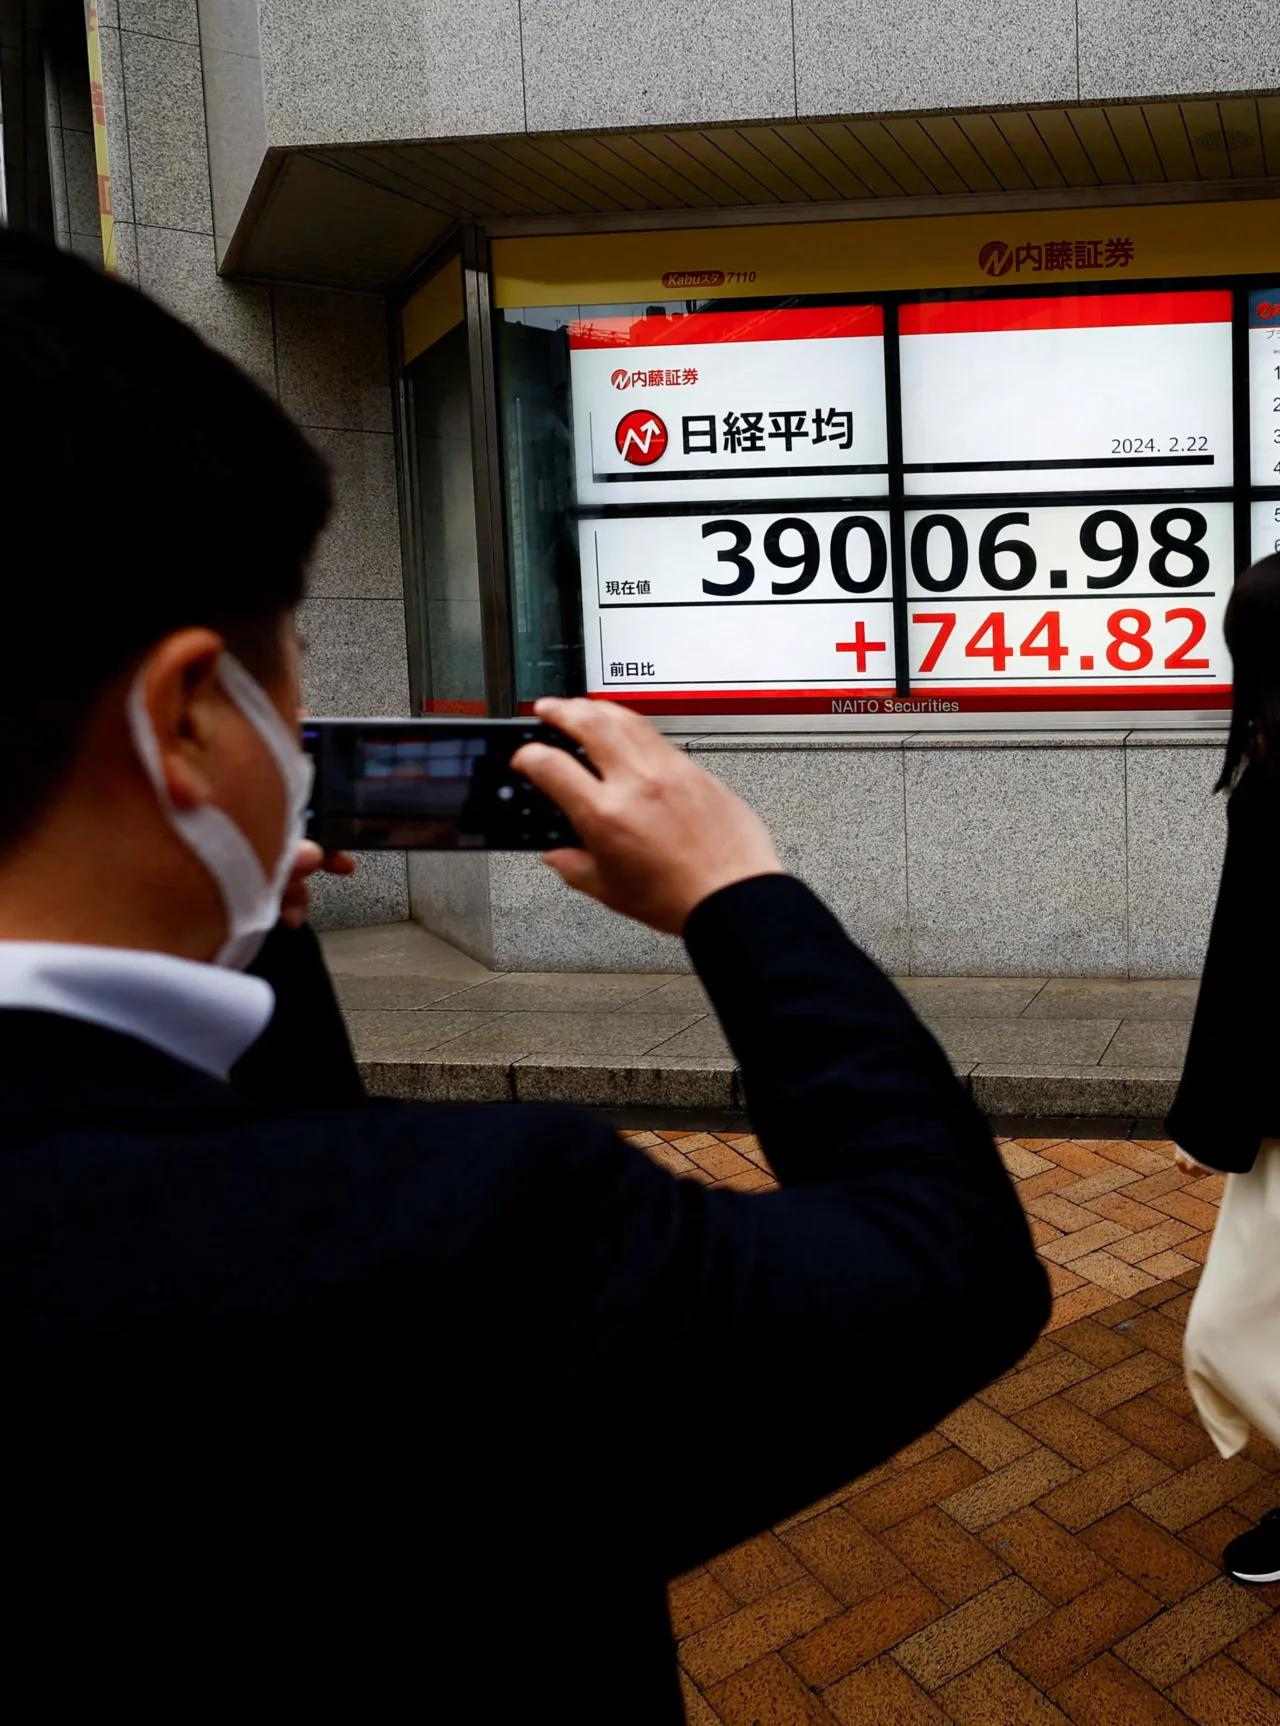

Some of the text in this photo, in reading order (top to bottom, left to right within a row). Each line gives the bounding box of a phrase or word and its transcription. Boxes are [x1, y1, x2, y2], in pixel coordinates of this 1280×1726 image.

[1015, 237, 1135, 272] 内藤証券
[727, 271, 758, 284] 7110
[631, 368, 699, 388] 内藤証券
[1273, 365, 1280, 381] 1
[681, 408, 853, 455] 日経平均
[605, 580, 651, 596] 現在値
[610, 662, 655, 677] 前日比
[831, 698, 959, 714] NAITO Securities
